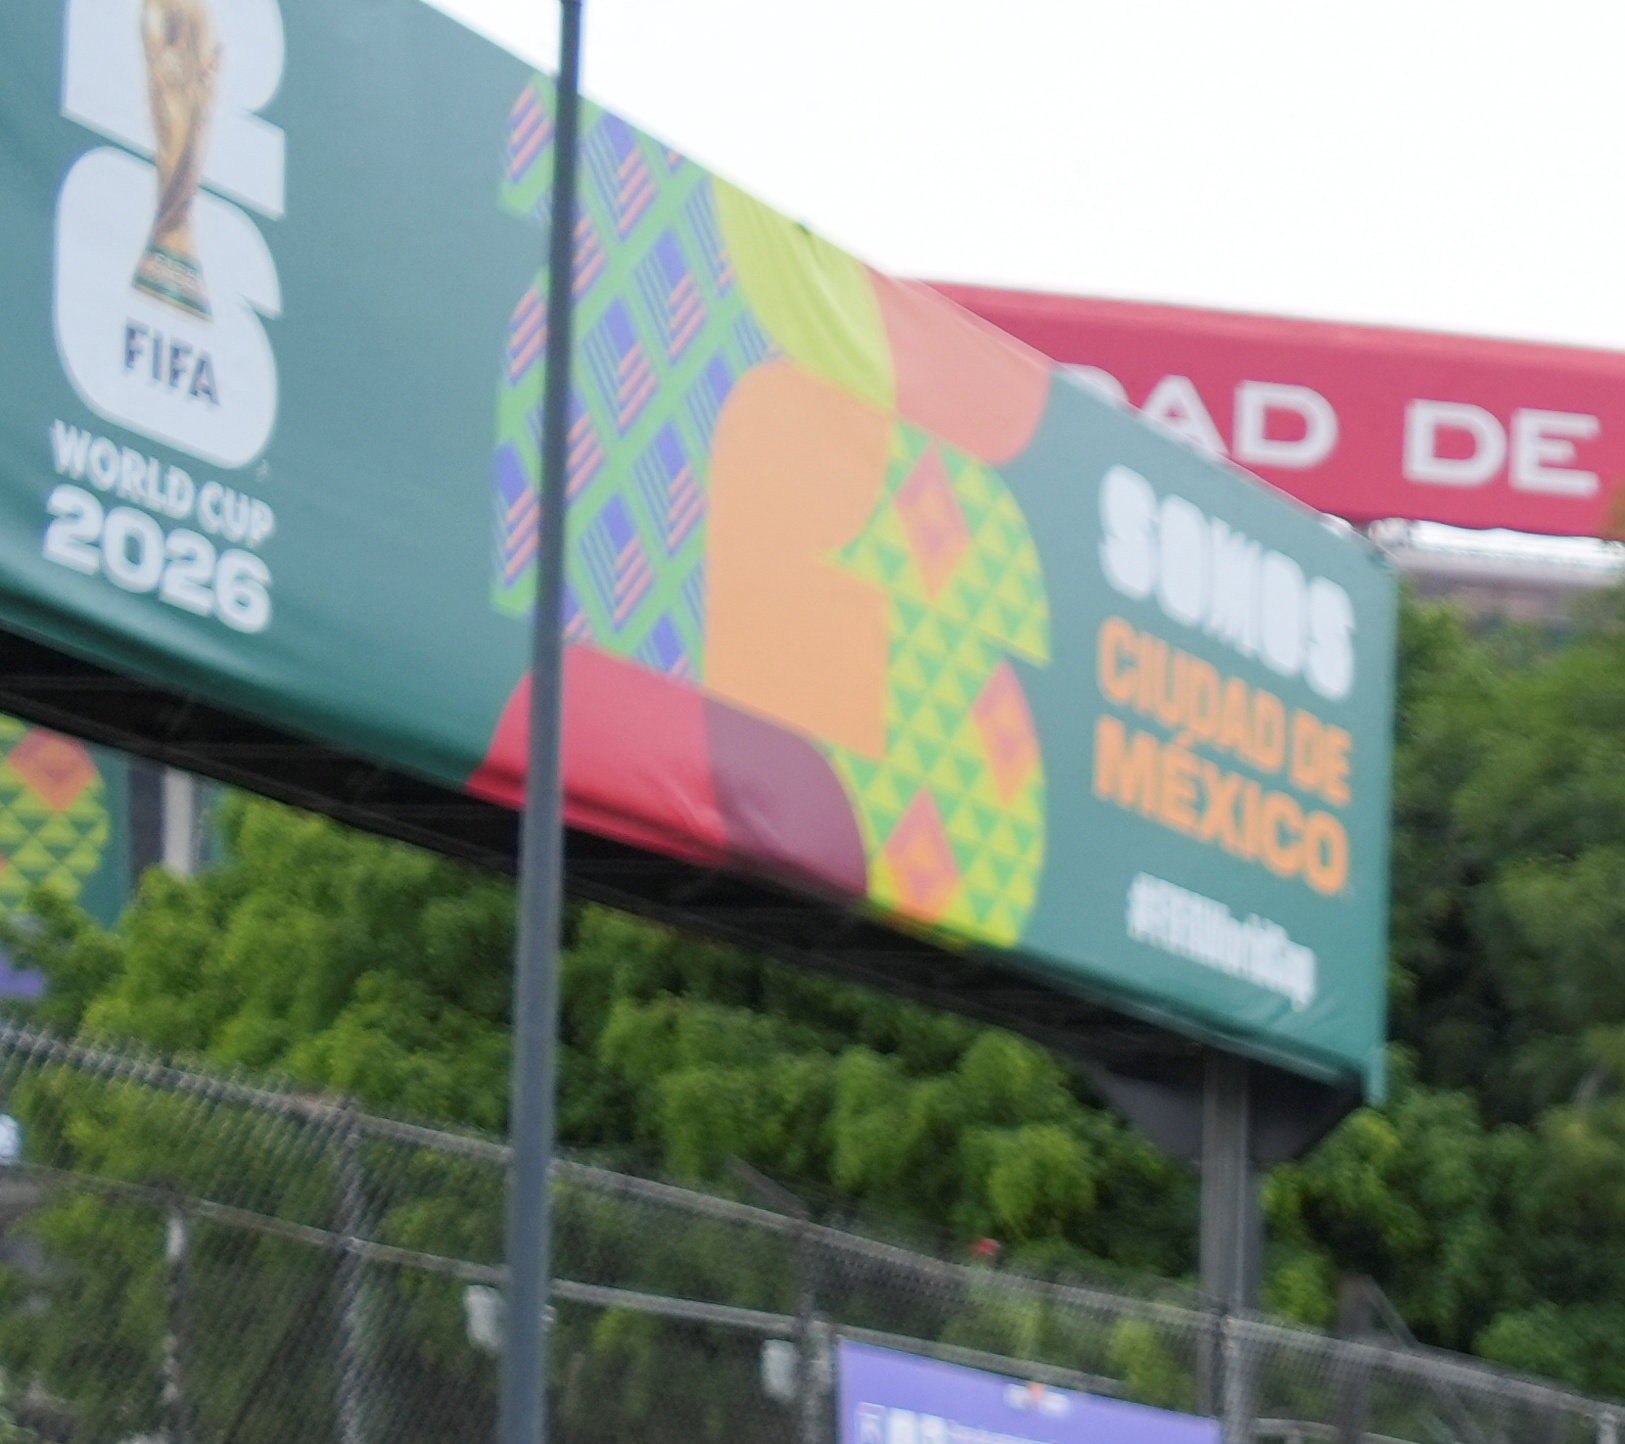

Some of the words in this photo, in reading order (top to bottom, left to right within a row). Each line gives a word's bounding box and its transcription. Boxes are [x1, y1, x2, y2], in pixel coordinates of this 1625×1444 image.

[121, 316, 221, 408] FIFA
[1060, 362, 1340, 470] AD
[1402, 397, 1602, 499] DE
[43, 483, 273, 636] 2026
[51, 419, 195, 521] WORLD
[196, 480, 275, 550] CUP
[1098, 462, 1356, 702] SOMOS
[1095, 615, 1286, 774] CIUDAD
[1291, 722, 1352, 808] DE
[1090, 713, 1350, 898] MÉXICO
